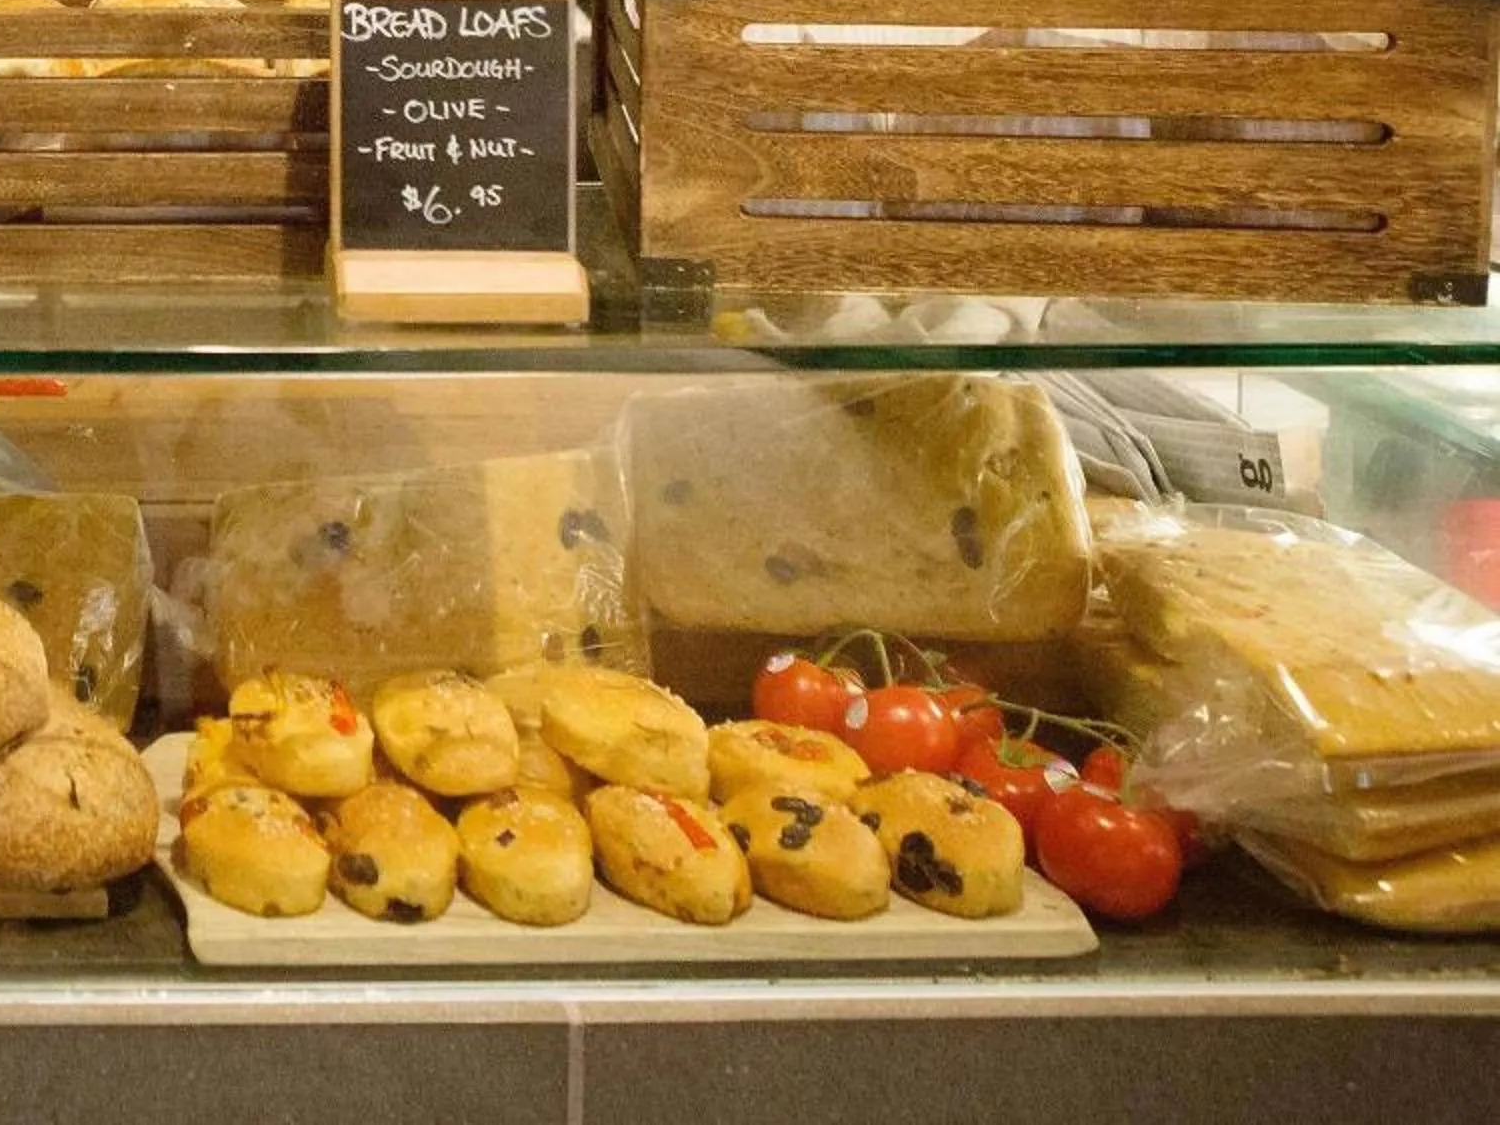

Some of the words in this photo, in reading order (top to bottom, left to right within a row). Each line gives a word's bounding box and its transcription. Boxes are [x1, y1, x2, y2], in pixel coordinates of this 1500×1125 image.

[341, 2, 447, 42] BREAD
[458, 5, 552, 40] LOAFS
[403, 98, 485, 124] OLIVE
